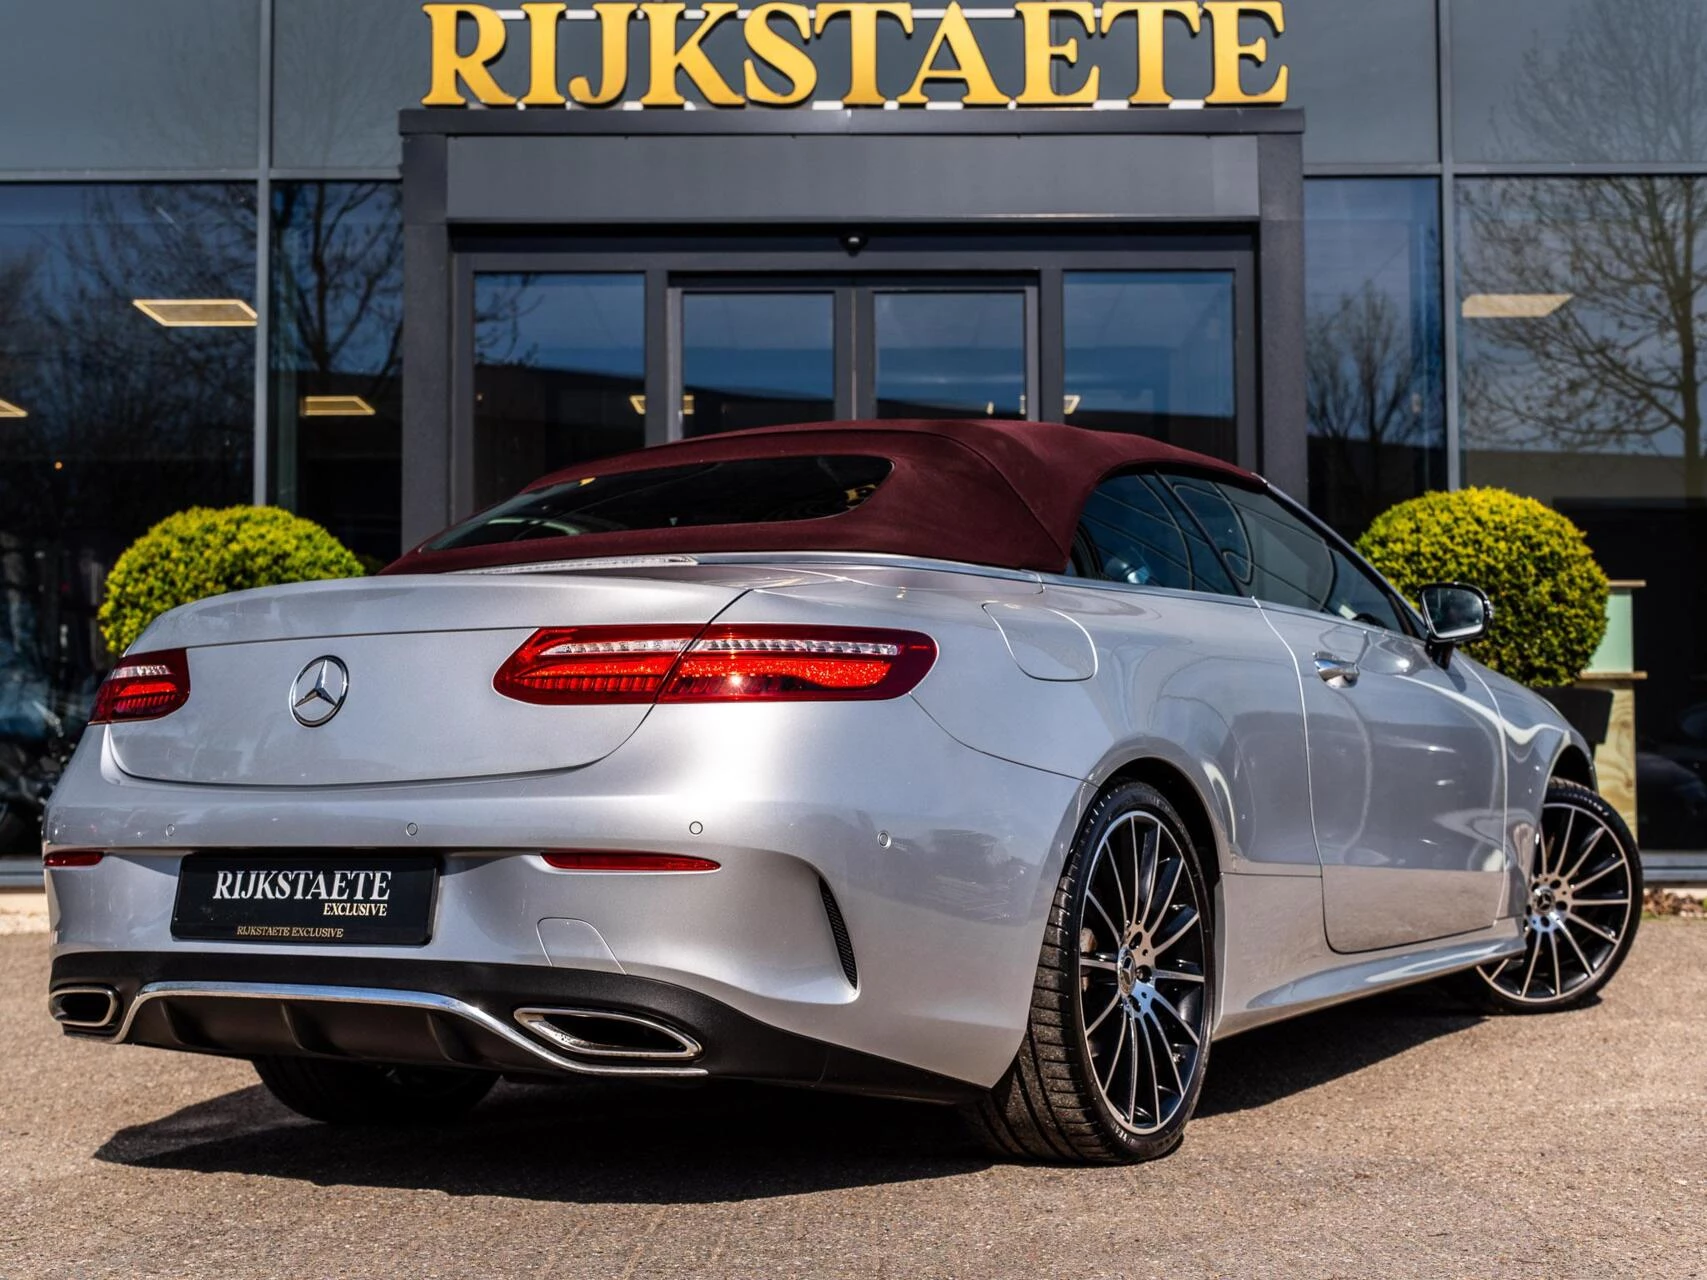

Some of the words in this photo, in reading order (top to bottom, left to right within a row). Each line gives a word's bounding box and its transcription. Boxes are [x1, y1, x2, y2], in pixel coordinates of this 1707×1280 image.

[421, 1, 1289, 107] RIJKSTAETE
[212, 870, 392, 901] RIJKSTAETE
[323, 902, 388, 917] EXCLUSIVE
[236, 925, 290, 937] RIJKSTAETE
[291, 926, 344, 938] EXCLUSIVE
